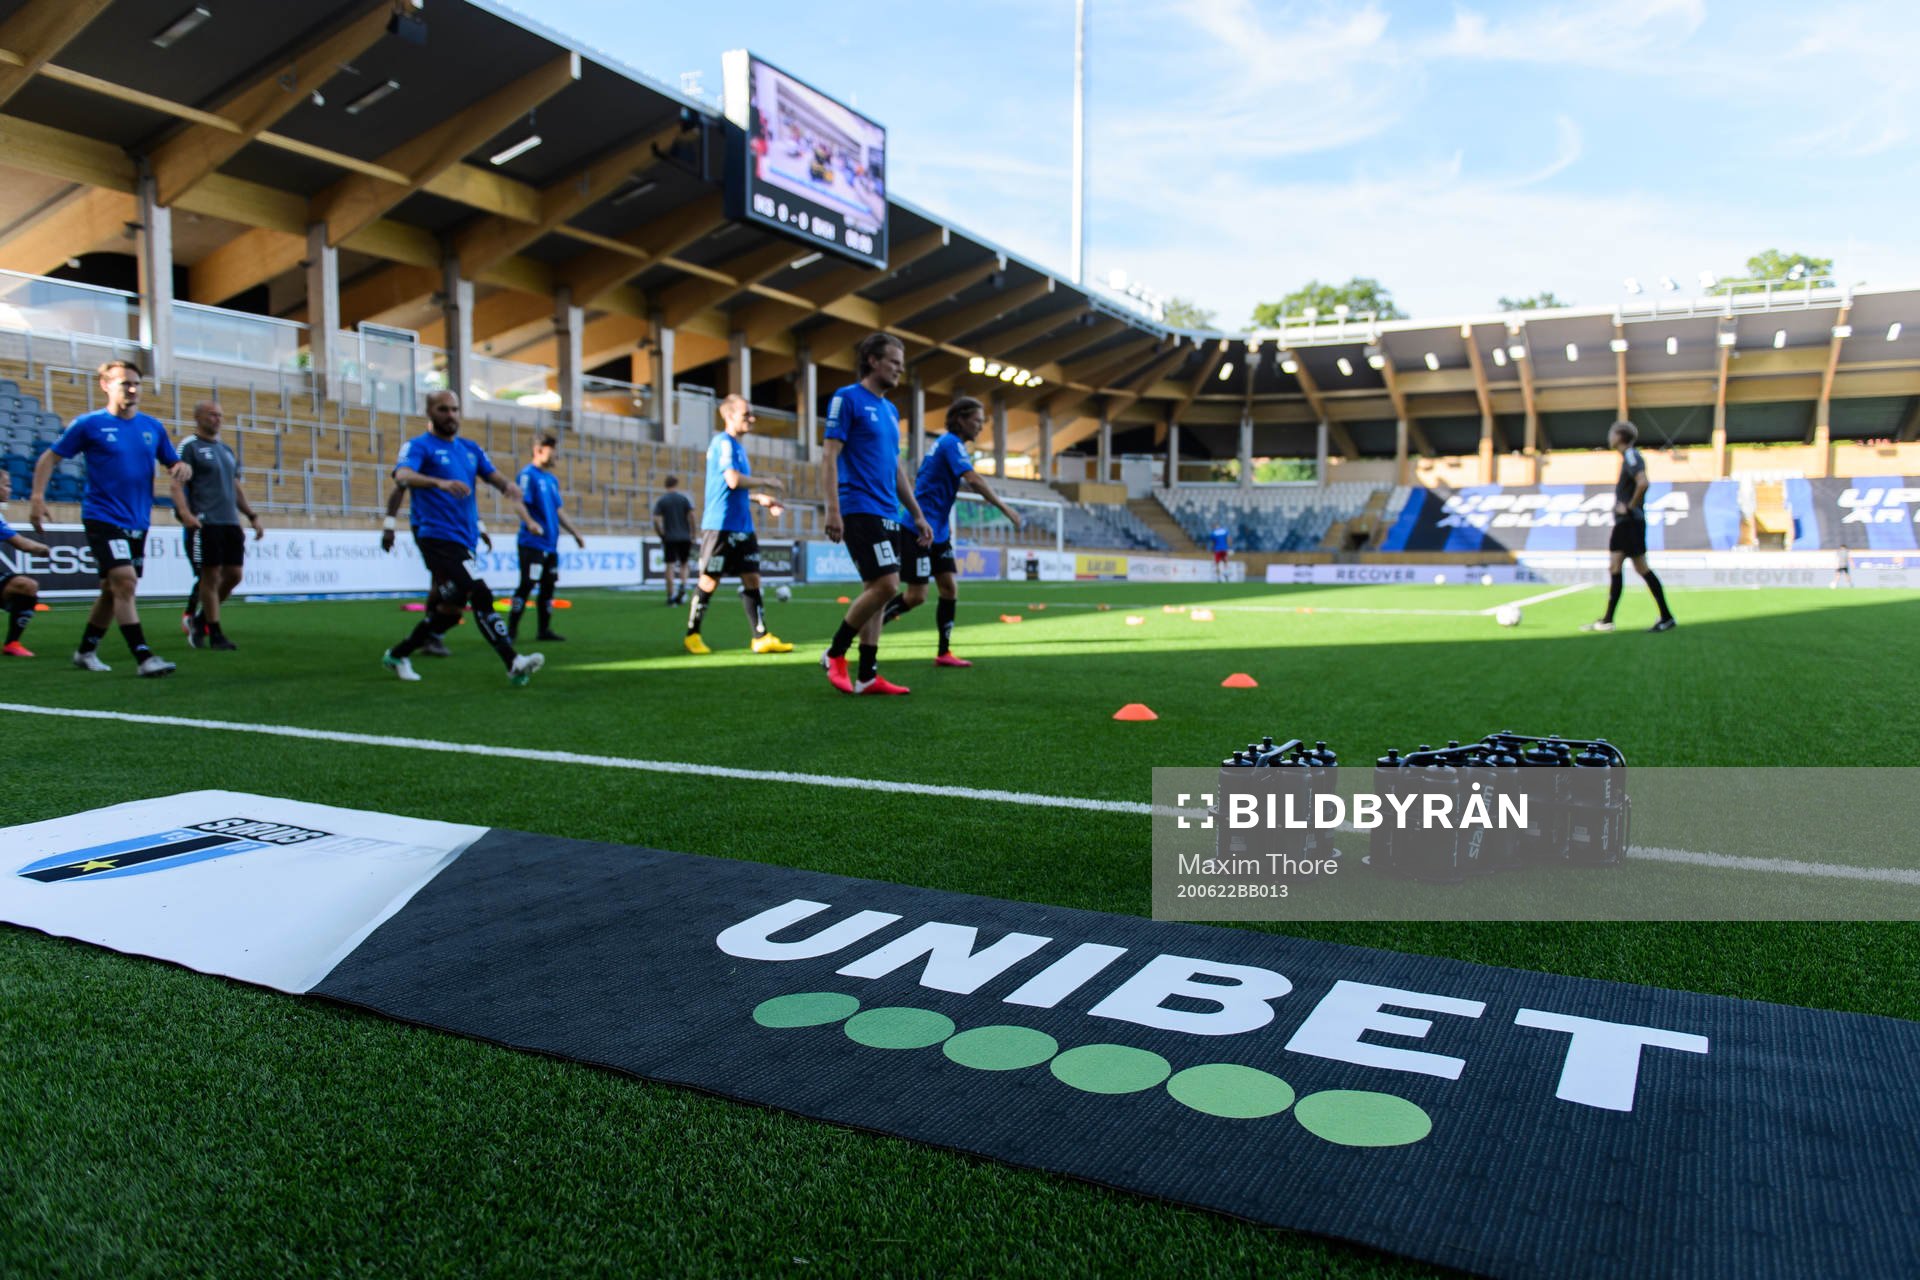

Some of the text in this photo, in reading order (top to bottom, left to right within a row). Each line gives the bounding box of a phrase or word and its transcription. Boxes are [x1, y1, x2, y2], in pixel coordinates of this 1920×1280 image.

[1441, 491, 1689, 513] UPPSAA
[286, 538, 305, 560] &
[478, 551, 637, 572] SYSMSVETS
[1335, 567, 1415, 581] RECOVER
[1712, 569, 1814, 584] RECOVER
[196, 817, 328, 845] SIRIUS
[715, 897, 1709, 1112] UNIBET
